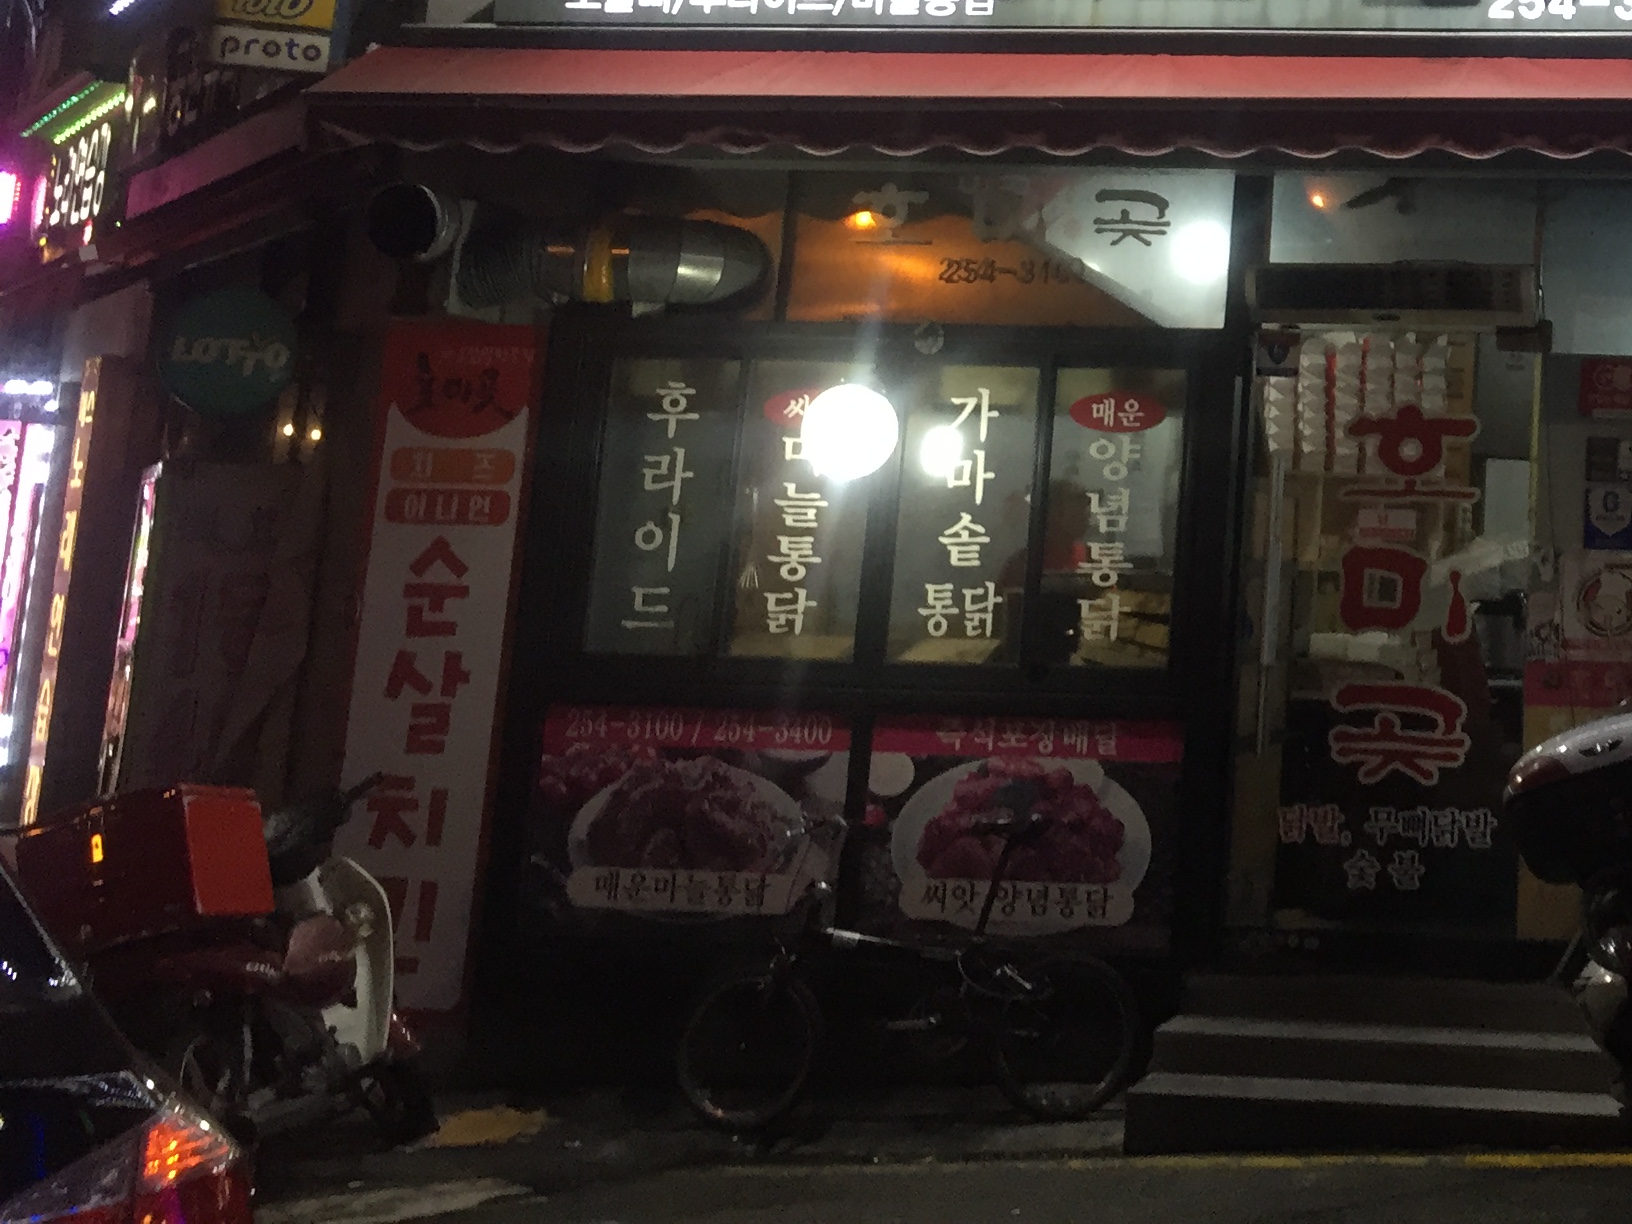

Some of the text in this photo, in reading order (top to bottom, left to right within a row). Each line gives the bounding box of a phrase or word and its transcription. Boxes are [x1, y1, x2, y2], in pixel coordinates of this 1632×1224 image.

[220, 35, 322, 62] proto
[1091, 396, 1146, 427] 매운
[620, 380, 700, 630] 후라이드
[937, 387, 999, 568] 가마솥
[1076, 435, 1141, 642] 양념통닭
[917, 581, 1003, 639] 통닭
